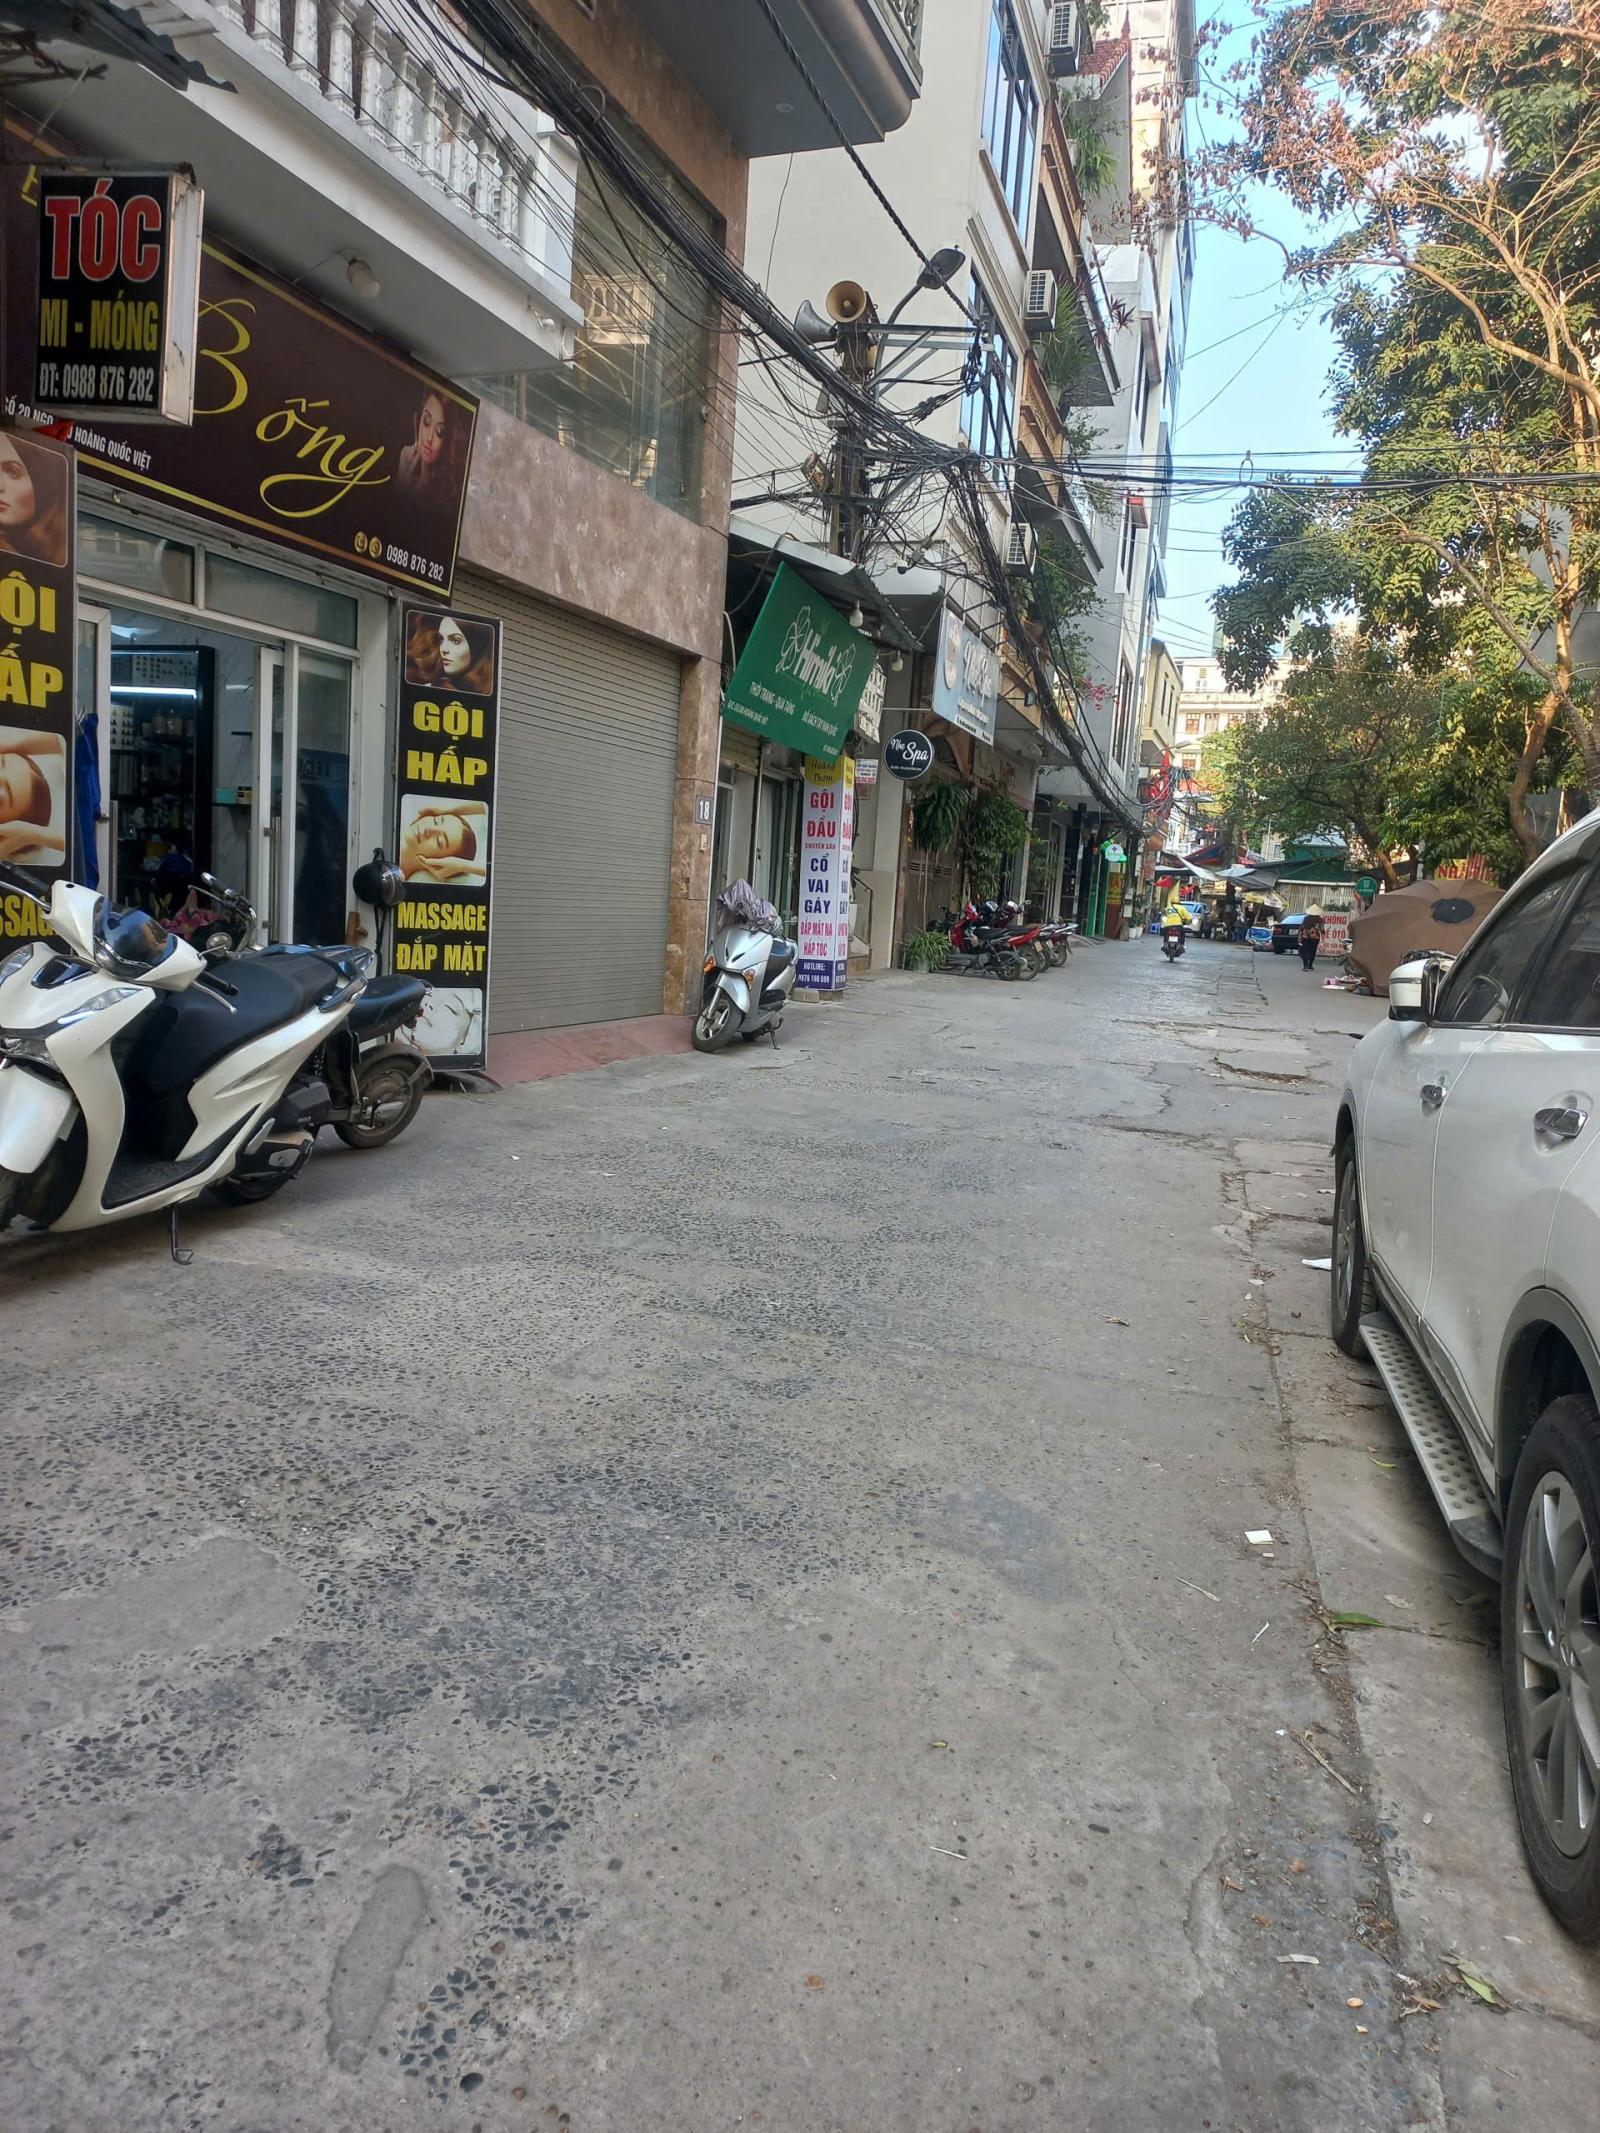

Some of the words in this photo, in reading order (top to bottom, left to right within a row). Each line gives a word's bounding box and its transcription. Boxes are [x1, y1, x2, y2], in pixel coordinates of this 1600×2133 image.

[45, 178, 162, 282] TÓC
[40, 299, 68, 347] MI
[90, 289, 159, 351] MÓNG
[40, 363, 58, 398] ĐT:
[62, 364, 96, 399] 0988
[100, 366, 125, 400] 876
[128, 367, 154, 402] 282
[75, 426, 106, 452] HOÀNG
[108, 440, 131, 462] QUỐC
[133, 450, 151, 471] VIỆT
[386, 544, 408, 567] 0988
[410, 555, 426, 574] 876
[428, 562, 444, 581] 282
[413, 701, 484, 740] GỘI
[407, 745, 488, 786] HẤP
[903, 741, 929, 766] Spa
[699, 800, 710, 820] 18
[811, 788, 834, 812] GỘI
[807, 815, 836, 837] ĐẦU
[811, 853, 829, 872] CỔ
[808, 879, 829, 893] VAI
[397, 902, 486, 931] MASSAGE
[804, 896, 831, 914] GÁY
[396, 936, 438, 970] ĐẮP
[444, 940, 486, 976] MẶT
